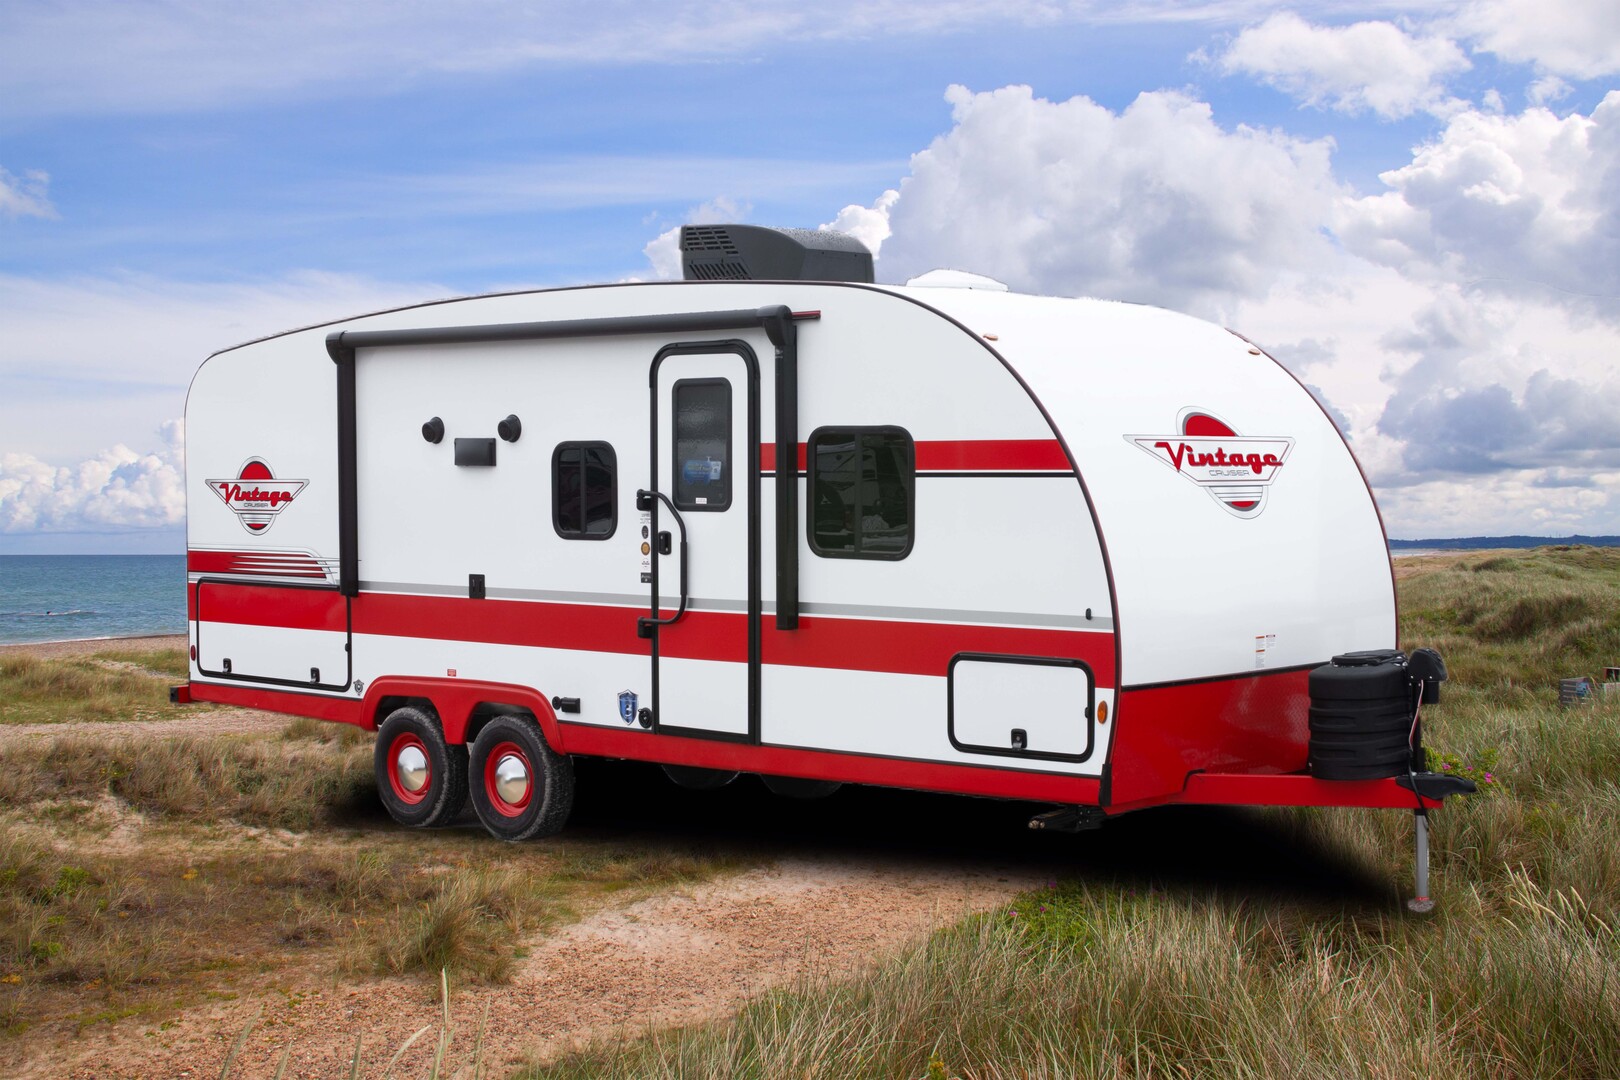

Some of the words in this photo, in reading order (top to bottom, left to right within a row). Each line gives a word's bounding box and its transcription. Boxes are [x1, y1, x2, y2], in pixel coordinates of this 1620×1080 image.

[1154, 442, 1283, 474] Vintage
[1208, 469, 1250, 477] CRUISER
[219, 483, 294, 507] Vintage
